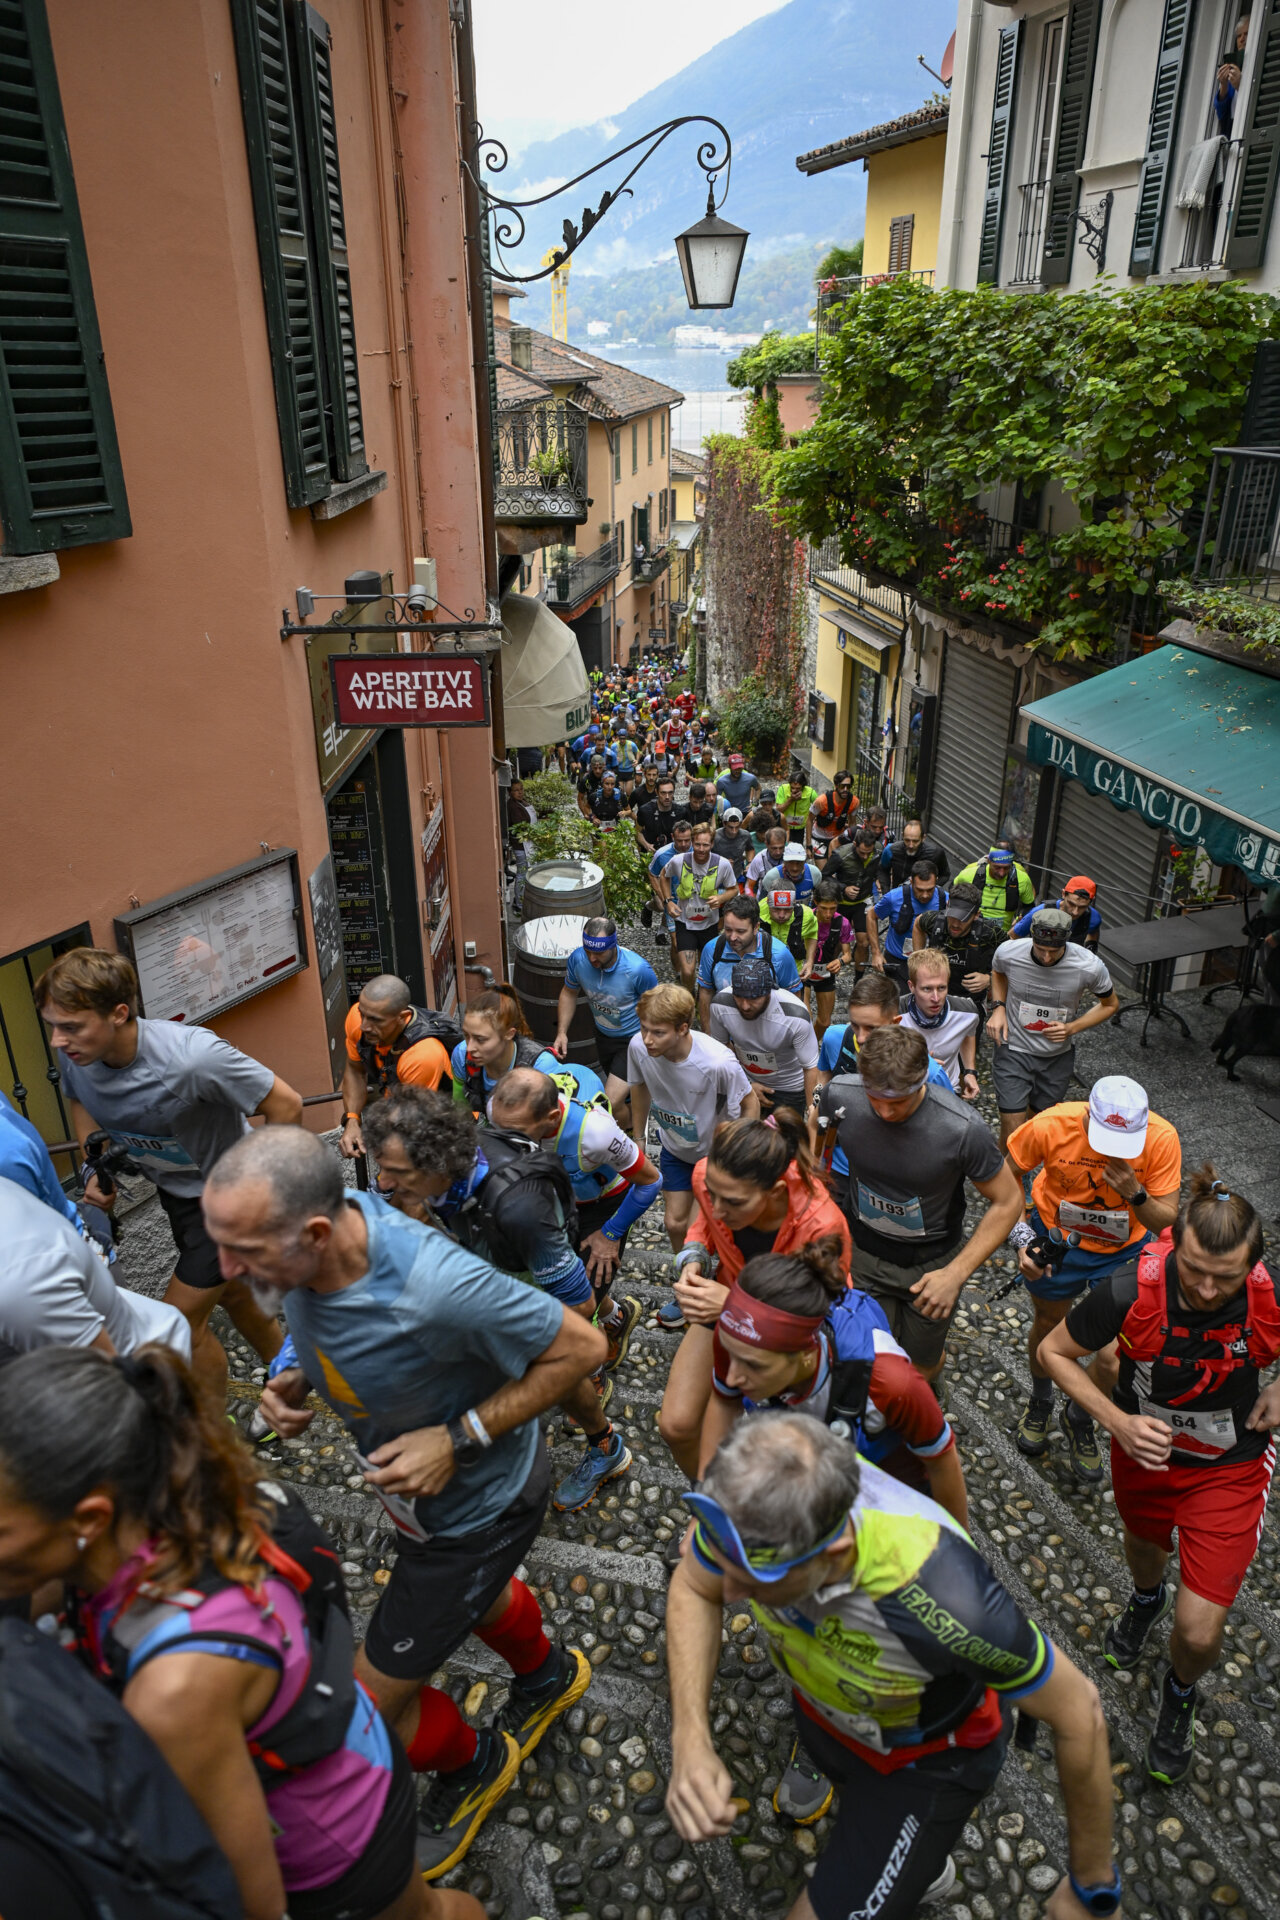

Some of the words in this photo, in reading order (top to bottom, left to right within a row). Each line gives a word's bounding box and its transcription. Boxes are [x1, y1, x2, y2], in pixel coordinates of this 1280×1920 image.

[349, 671, 473, 691] APERITIVI
[351, 691, 418, 709] WINE
[424, 690, 473, 709] BAR
[1036, 1008, 1049, 1018] 89
[746, 1053, 759, 1062] 90
[659, 1111, 682, 1127] 1031
[123, 1136, 163, 1151] 1010
[870, 1195, 905, 1216] 1193
[1080, 1212, 1107, 1225] 120
[1171, 1414, 1197, 1430] 64
[897, 1583, 970, 1645] FAST
[865, 1828, 912, 1917] CRAZY
